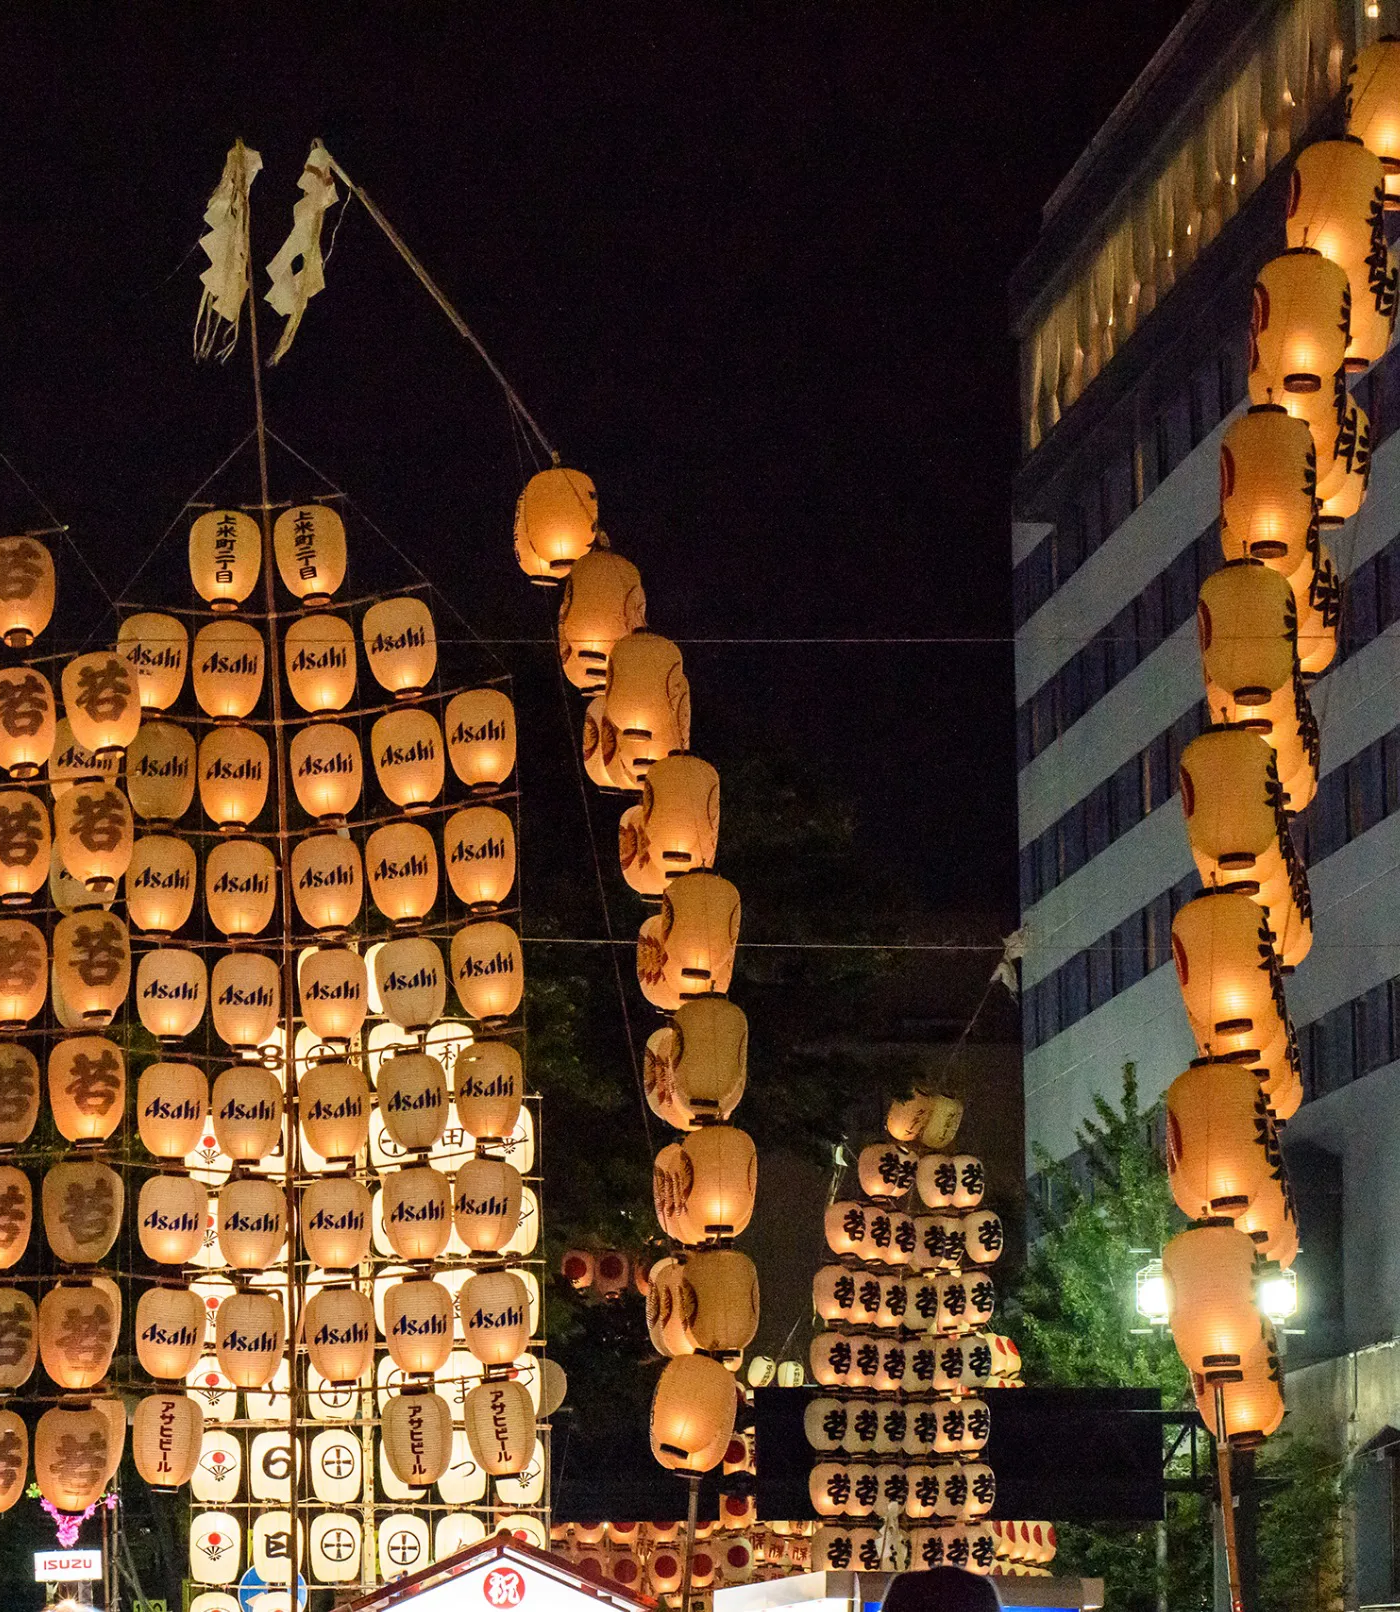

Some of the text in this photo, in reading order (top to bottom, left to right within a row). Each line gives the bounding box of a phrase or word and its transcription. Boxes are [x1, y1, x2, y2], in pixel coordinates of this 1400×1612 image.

[215, 514, 237, 584] 上米町二丁目
[293, 511, 317, 580] 上米町二丁目
[371, 627, 426, 654] Asahi
[125, 644, 181, 669] Asahi
[203, 653, 257, 675] Asahi
[292, 648, 347, 672] Asahi
[451, 721, 506, 745] Asahi
[380, 741, 435, 765] Asahi
[135, 755, 188, 777] Asahi
[206, 758, 262, 781] Asahi
[299, 755, 353, 776] Asahi
[451, 840, 505, 863] Asahi
[135, 869, 189, 890] Asahi
[299, 866, 353, 889] Asahi
[374, 855, 428, 881] Asahi
[214, 874, 269, 895] Asahi
[460, 954, 514, 978] Asahi
[144, 979, 198, 1001] Asahi
[305, 979, 360, 1001] Asahi
[383, 969, 438, 991] Asahi
[219, 985, 273, 1007] Asahi
[259, 1045, 284, 1070] 8
[460, 1075, 514, 1098] Asahi
[145, 1097, 200, 1121] Asahi
[220, 1099, 275, 1121] Asahi
[307, 1096, 362, 1120] Asahi
[387, 1088, 442, 1114] Asahi
[441, 1127, 465, 1148] 田
[391, 1200, 445, 1223] Asahi
[454, 1195, 508, 1217] Asahi
[144, 1210, 198, 1232] Asahi
[225, 1211, 280, 1233] Asahi
[309, 1209, 364, 1231] Asahi
[393, 1314, 447, 1338] Asahi
[469, 1307, 524, 1329] Asahi
[142, 1323, 196, 1345] Asahi
[223, 1331, 278, 1353] Asahi
[314, 1320, 369, 1345] Asahi
[159, 1401, 175, 1473] アサヒビール
[490, 1390, 512, 1462] アサヒビール
[408, 1405, 427, 1476] アサヒビール
[262, 1446, 295, 1480] 6
[449, 1459, 477, 1477] つ
[43, 1559, 91, 1570] ISUZU
[491, 1571, 520, 1605] 祝
